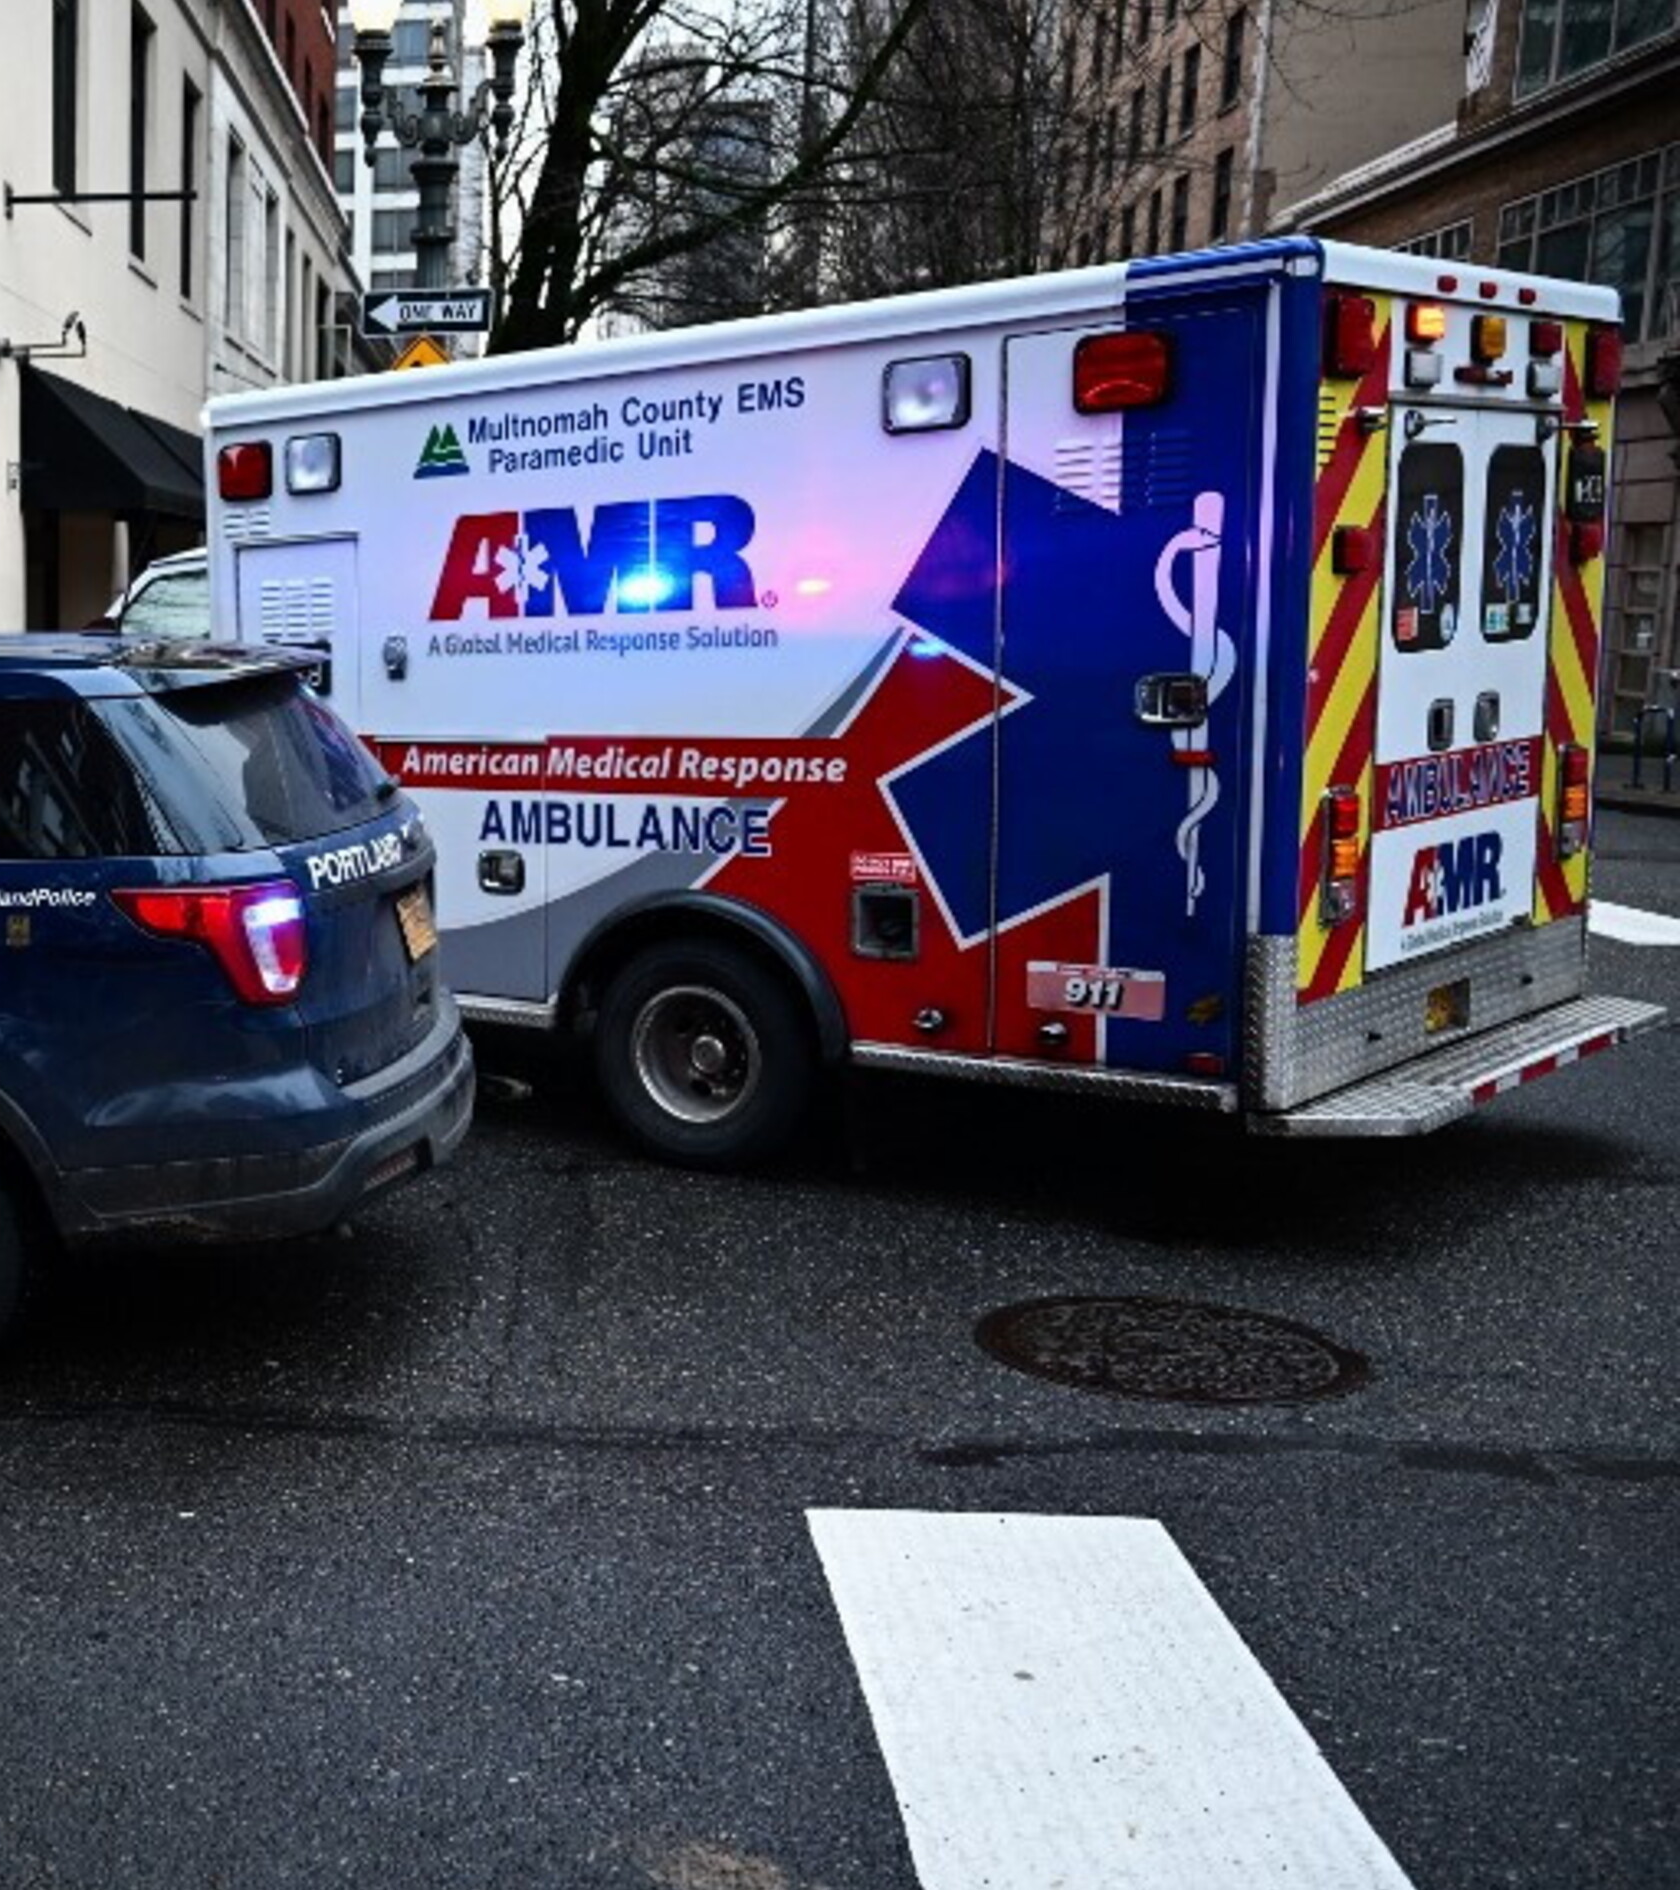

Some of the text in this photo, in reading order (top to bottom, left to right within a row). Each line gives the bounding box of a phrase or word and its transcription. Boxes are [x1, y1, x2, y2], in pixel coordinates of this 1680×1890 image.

[400, 303, 476, 321] ONE WAY
[468, 376, 805, 444] Multnomah County EMS
[488, 428, 692, 473] Paramedic Unit
[429, 494, 758, 621] AMR
[429, 624, 778, 657] A Global Medical Response Solution
[402, 745, 847, 788] American Medical Response
[1385, 741, 1531, 827] AMBULANCE
[479, 800, 771, 856] AMBULANCE
[1402, 831, 1503, 928] AMR
[1065, 978, 1124, 1009] 911
